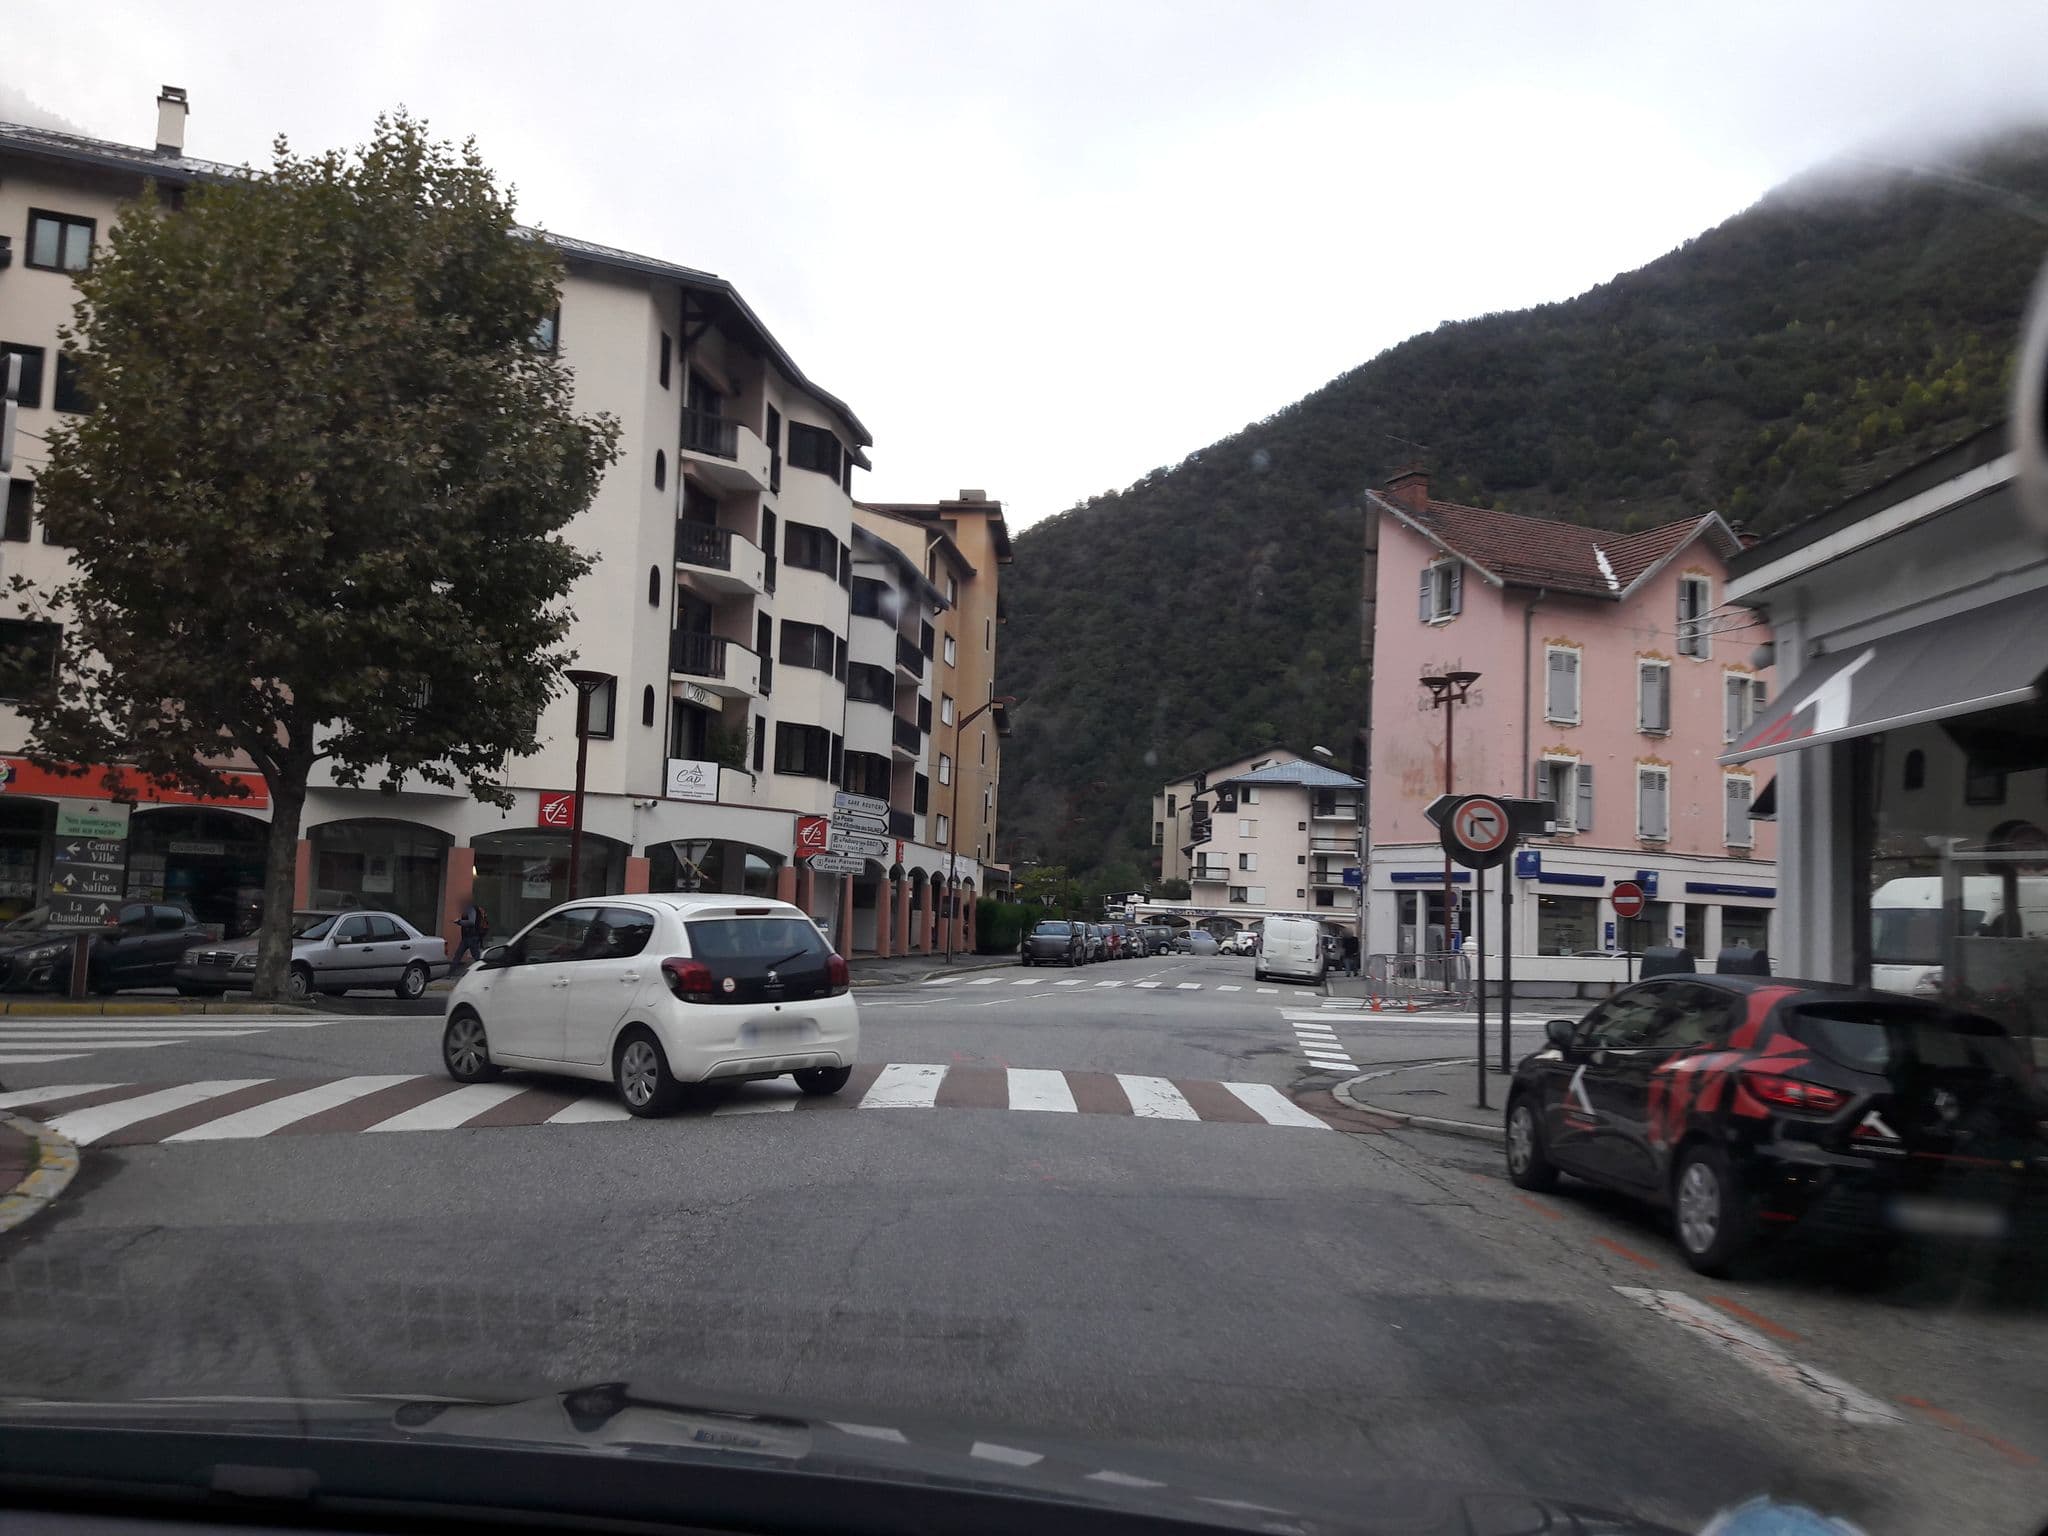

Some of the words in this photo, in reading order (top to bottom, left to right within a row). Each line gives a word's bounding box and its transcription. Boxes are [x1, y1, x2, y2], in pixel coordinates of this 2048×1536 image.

[677, 769, 702, 785] Cap
[87, 840, 120, 852] Centre
[91, 851, 115, 863] Ville
[92, 871, 110, 881] Les
[82, 881, 117, 893] Salines
[70, 901, 82, 911] La
[49, 911, 101, 924] Chaudanne
